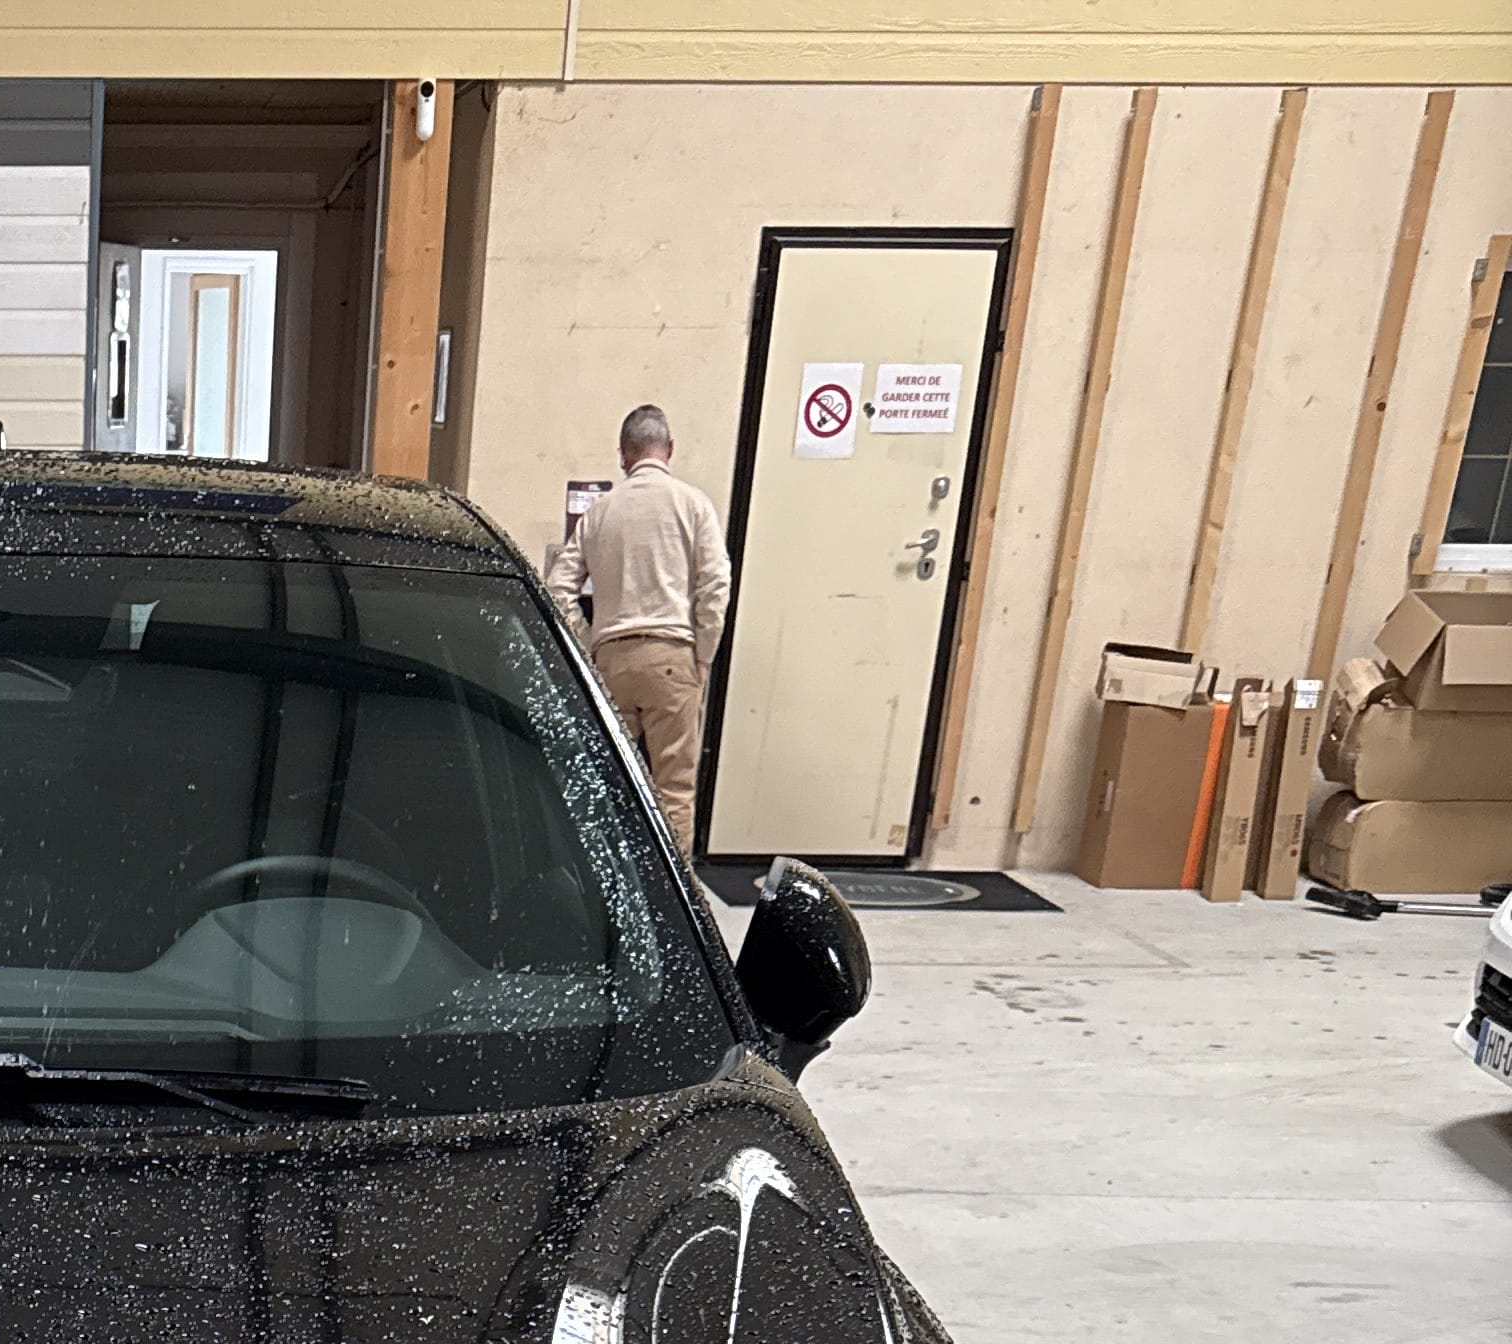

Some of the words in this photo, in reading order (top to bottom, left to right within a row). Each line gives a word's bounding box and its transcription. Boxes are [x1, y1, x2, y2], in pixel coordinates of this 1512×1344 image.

[896, 376, 926, 385] MERCI
[928, 376, 942, 385] DE
[882, 392, 921, 402] GARDER
[923, 392, 951, 402] CETTE
[879, 409, 910, 419] PORTE
